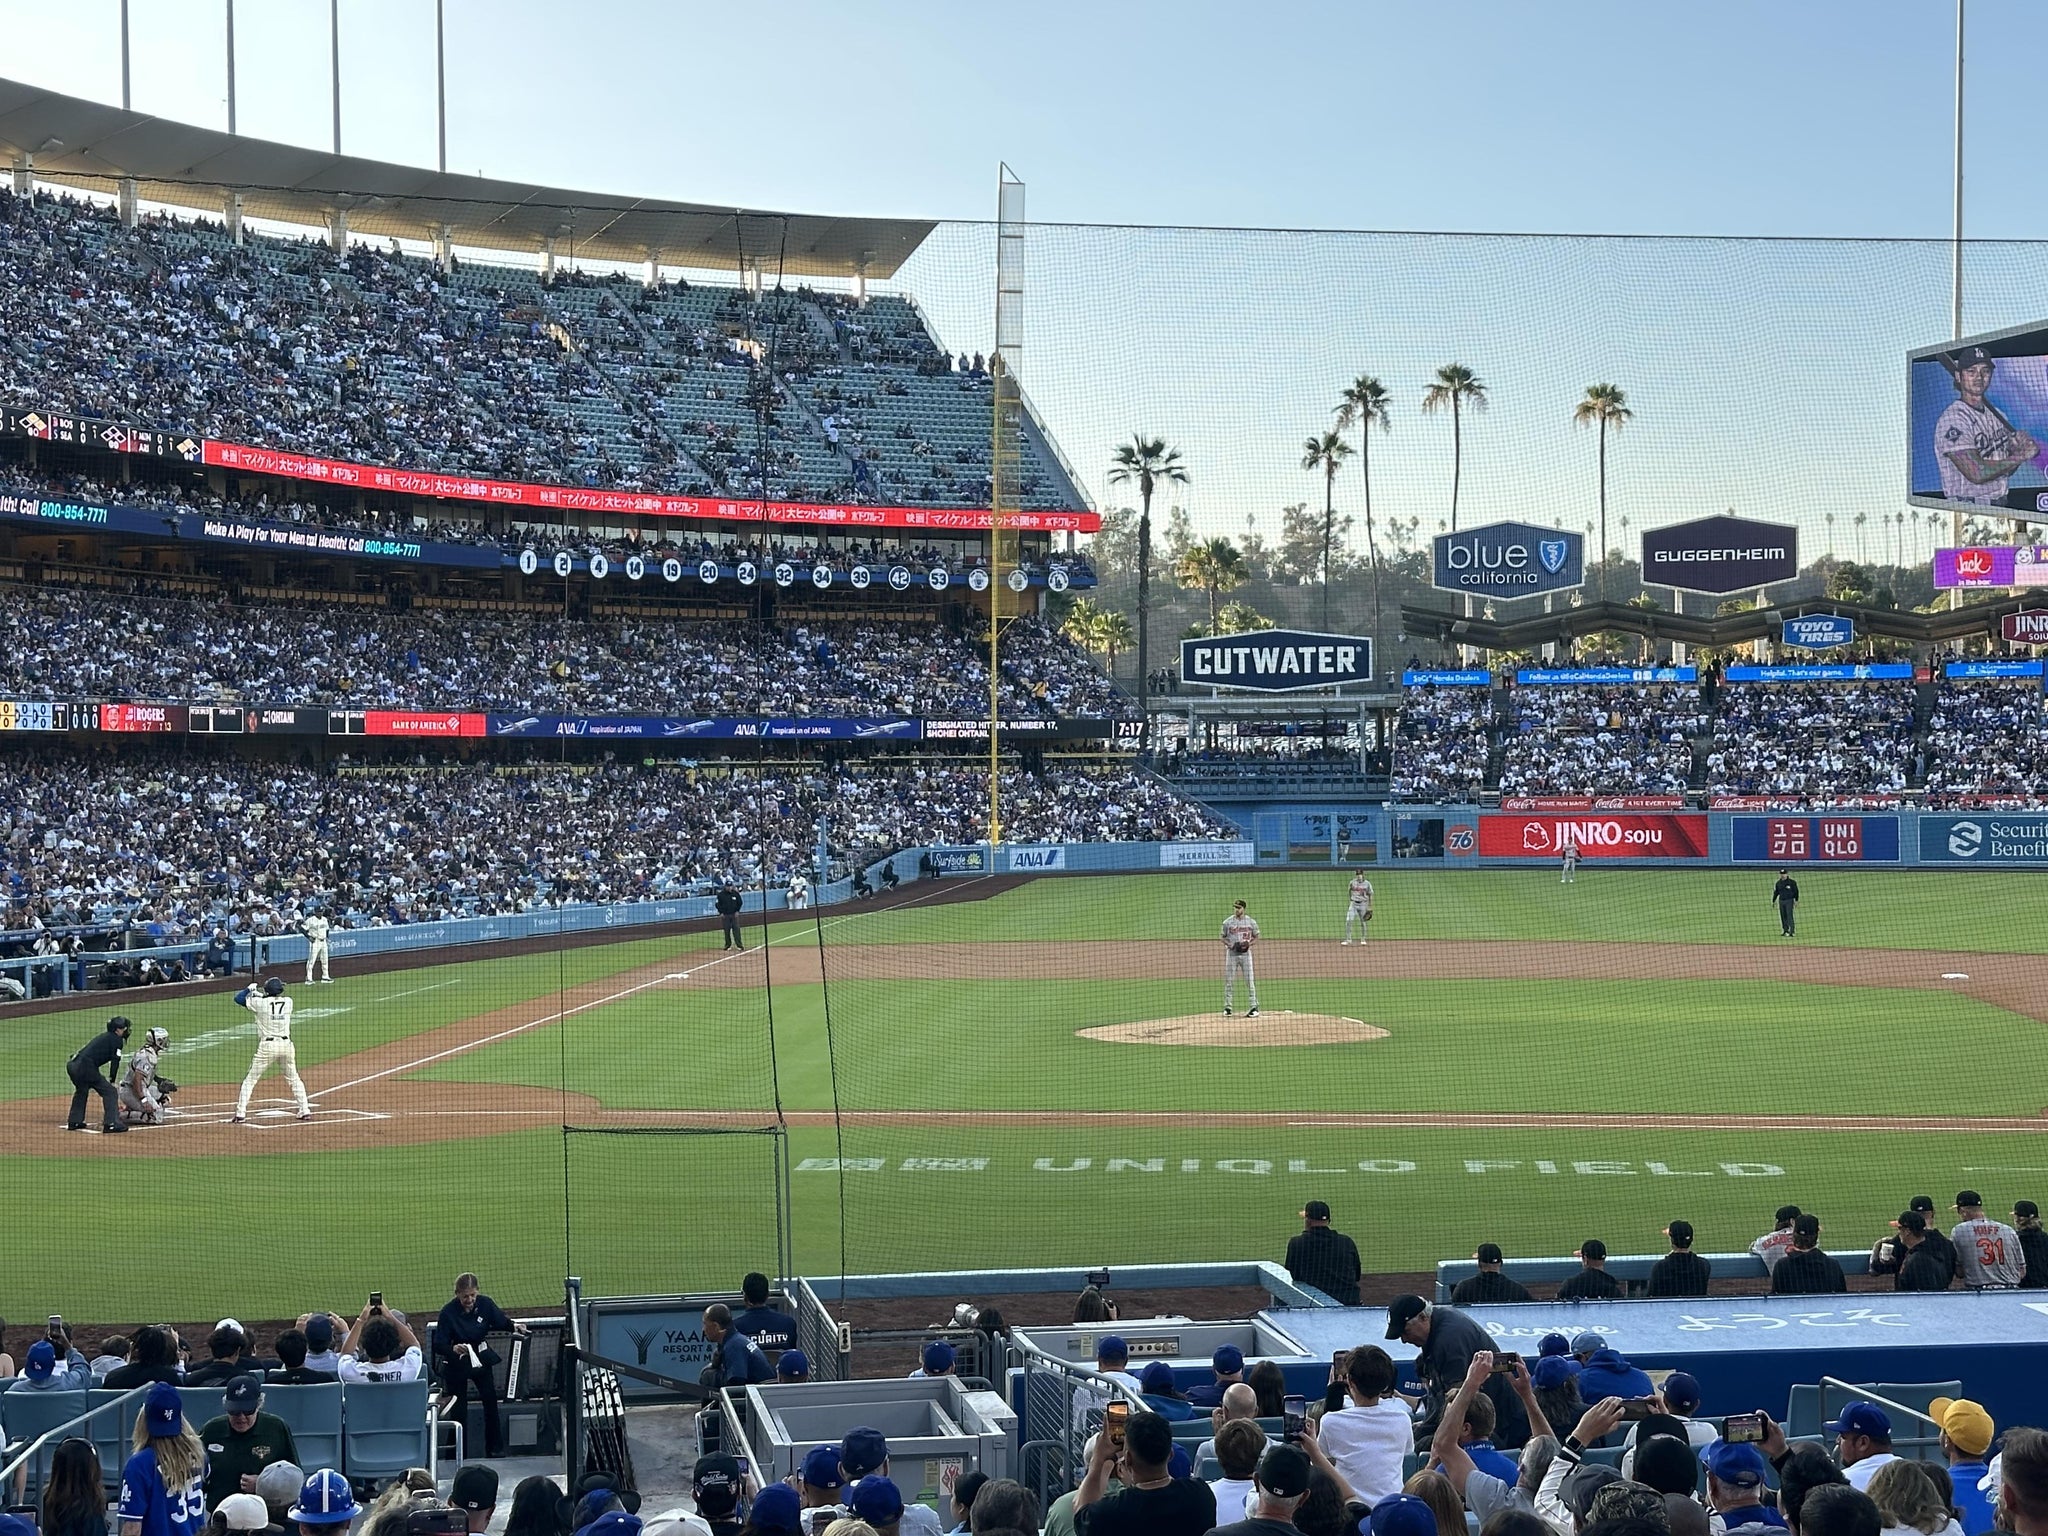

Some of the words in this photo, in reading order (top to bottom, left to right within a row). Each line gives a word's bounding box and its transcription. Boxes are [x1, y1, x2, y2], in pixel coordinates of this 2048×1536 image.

[80, 421, 86, 432] 0
[60, 431, 72, 441] SEA
[80, 433, 86, 444] 0
[20, 498, 40, 516] Call
[40, 501, 108, 523] 800-854-7771
[204, 520, 227, 538] Make
[228, 526, 235, 538] A
[236, 526, 254, 544] Play
[255, 527, 268, 541] For
[270, 528, 288, 544] Your
[318, 533, 347, 551] Health!
[348, 538, 364, 553] Call
[364, 540, 420, 558] 800-854-7771
[1447, 538, 1528, 569] blue
[1654, 547, 1785, 562] GUGGENHEIM
[526, 554, 531, 569] 1
[560, 556, 568, 570] 2
[594, 560, 603, 574] 4
[628, 561, 642, 576] 14
[1957, 552, 1991, 574] Jack
[666, 562, 678, 577] 19
[702, 566, 716, 578] 20
[738, 568, 755, 580] 24
[776, 568, 792, 582] 32
[814, 570, 830, 585] 34
[854, 570, 868, 584] 39
[892, 570, 908, 584] 42
[931, 572, 947, 585] 53
[1460, 570, 1538, 585] california
[1791, 622, 1834, 632] TOYO
[1798, 632, 1845, 642] TIRES
[1194, 646, 1356, 675] CUTWATER
[4, 704, 10, 714] 0
[22, 704, 28, 714] 0
[40, 704, 46, 714] 0
[136, 708, 166, 722] ROGERS
[4, 718, 10, 728] 0
[22, 718, 28, 728] 0
[40, 718, 46, 728] 0
[72, 713, 78, 728] 0
[82, 713, 88, 728] 0
[92, 713, 98, 728] 0
[392, 720, 410, 729] BANK
[410, 721, 418, 730] OF
[420, 722, 447, 730] AMERICA
[926, 720, 977, 730] DESIGNATED
[978, 720, 1009, 731] HITER,
[1010, 720, 1046, 730] NUMBER
[1046, 720, 1058, 731] 17,
[734, 724, 758, 736] ANA
[926, 730, 957, 738] SHOHEI
[1118, 722, 1144, 736] 7:17
[1553, 822, 1622, 852] JINRO
[1624, 829, 1662, 846] SOJU
[1774, 824, 1804, 838] ユニ
[1824, 824, 1855, 838] UNI
[1450, 830, 1473, 850] 76
[1773, 840, 1804, 855] クロ
[1824, 840, 1858, 856] QLO
[1014, 853, 1043, 867] ANA
[1178, 852, 1216, 860] MERRILL
[270, 1002, 286, 1014] 17
[1032, 1158, 1416, 1174] UNIQLO
[1463, 1160, 1786, 1176] FIELD
[1976, 1238, 2004, 1266] 31
[1677, 1308, 1910, 1332] ようこそ
[662, 1344, 704, 1354] RESORT
[706, 1344, 712, 1352] &
[680, 1354, 700, 1362] SAN
[166, 1475, 205, 1524] 35
